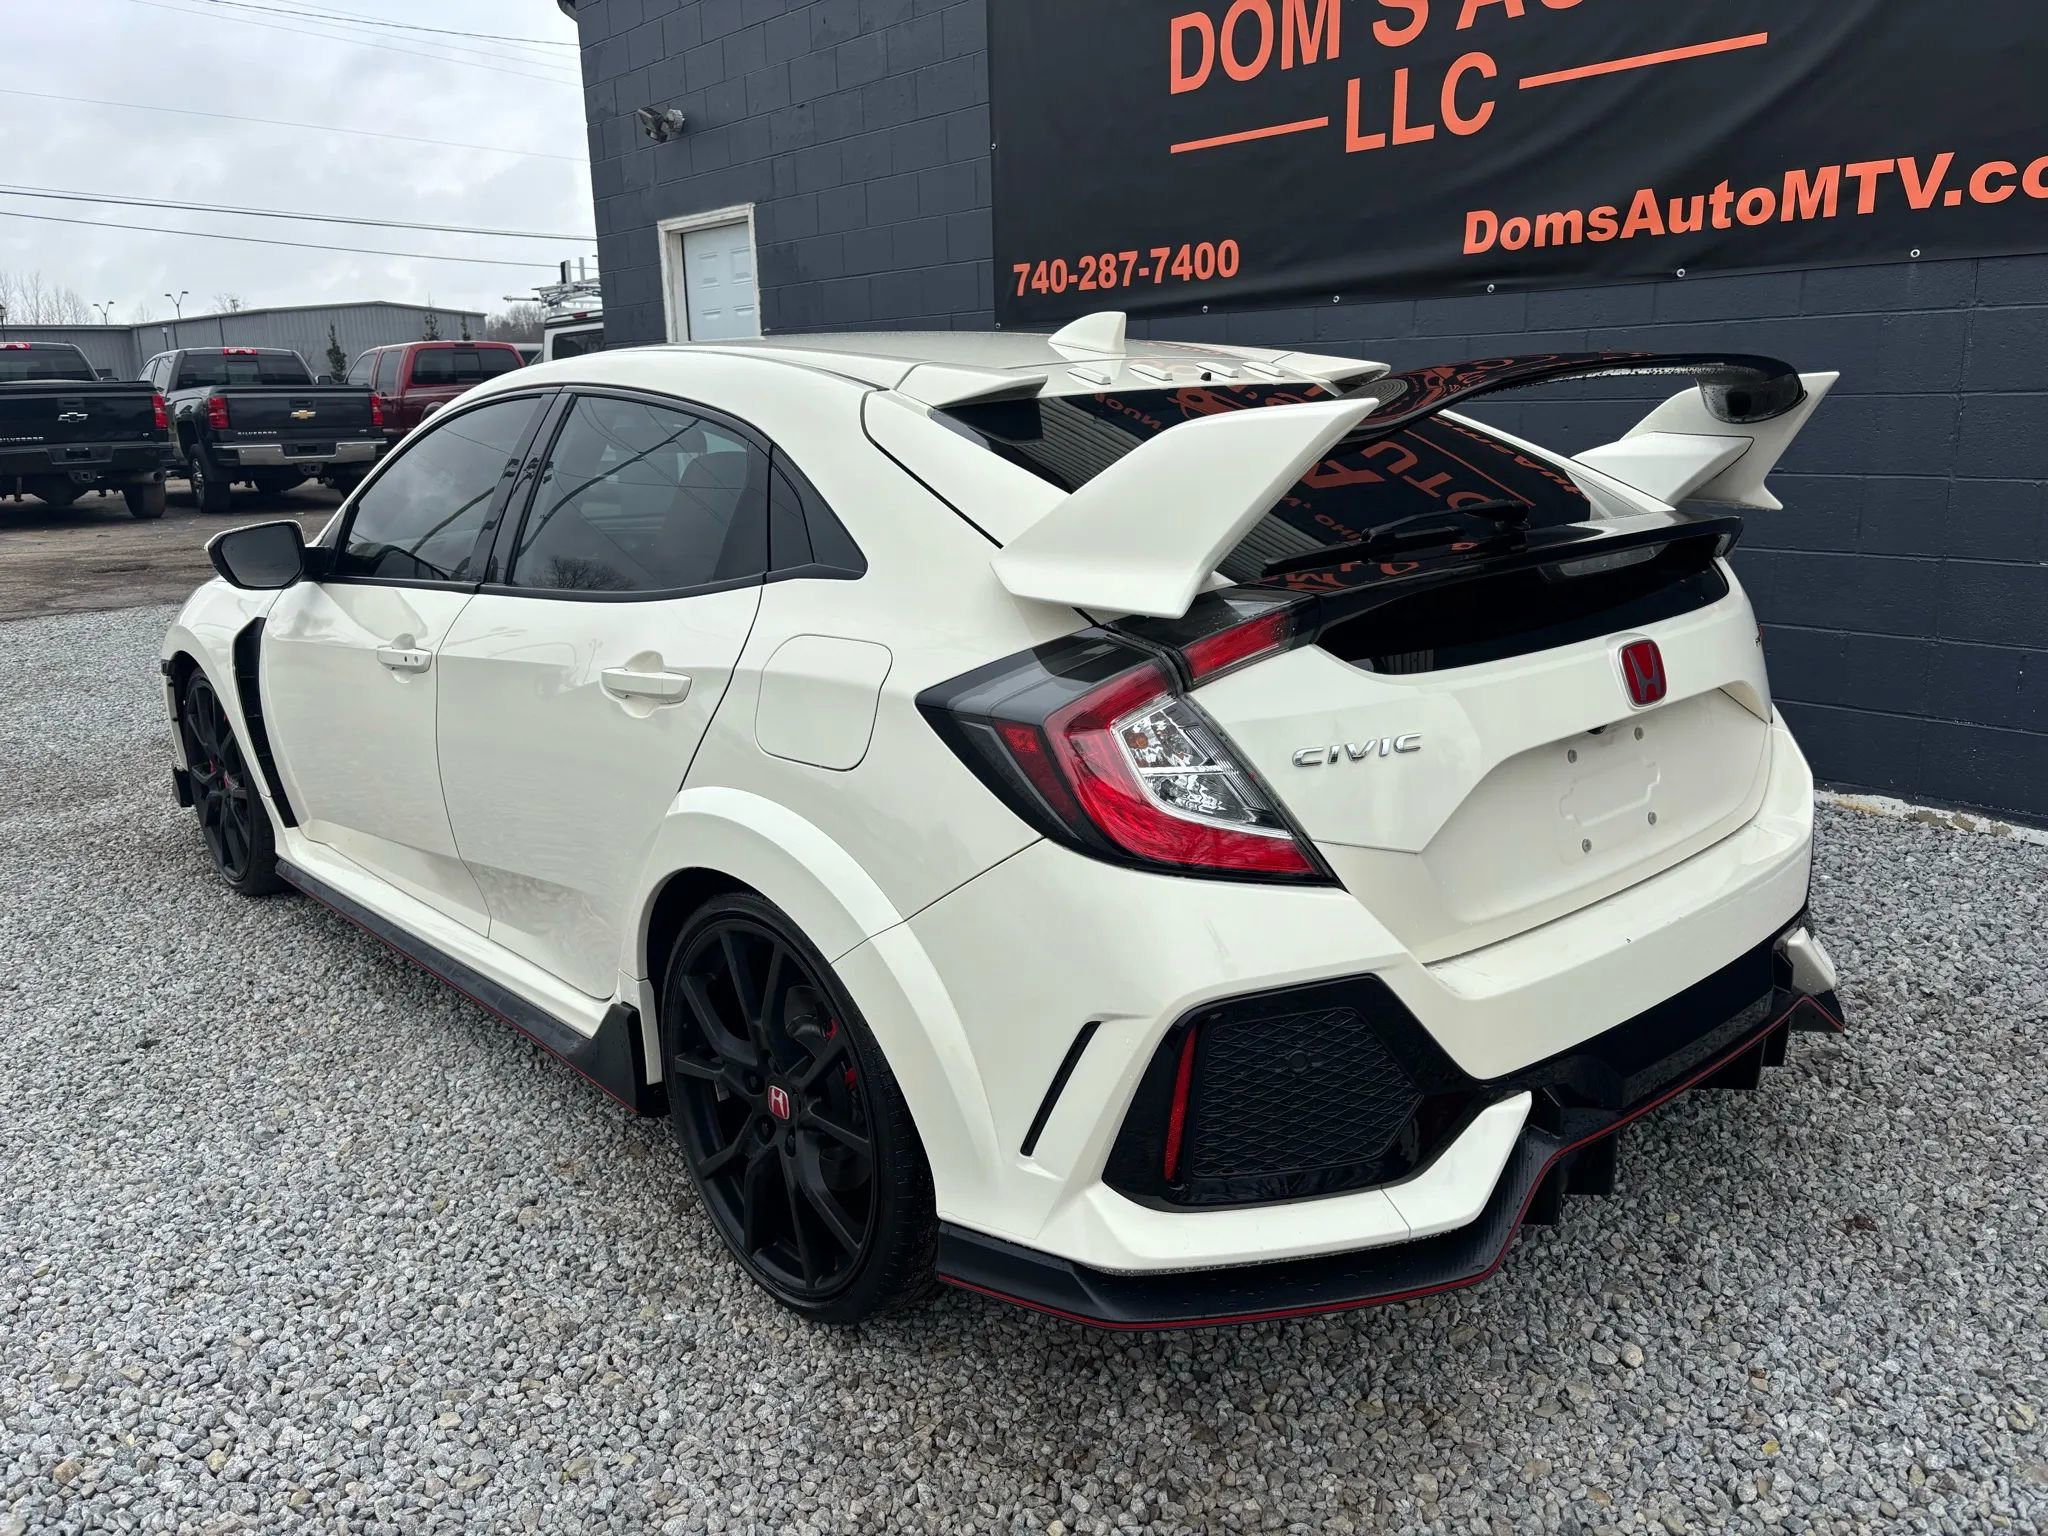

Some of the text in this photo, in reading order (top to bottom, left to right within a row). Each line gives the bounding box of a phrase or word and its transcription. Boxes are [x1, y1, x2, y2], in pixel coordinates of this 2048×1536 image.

[1171, 0, 1428, 94] DOMS
[1346, 52, 1498, 153] LLC
[1013, 239, 1240, 296] 740-287-7400
[1292, 732, 1422, 768] CIVIC
